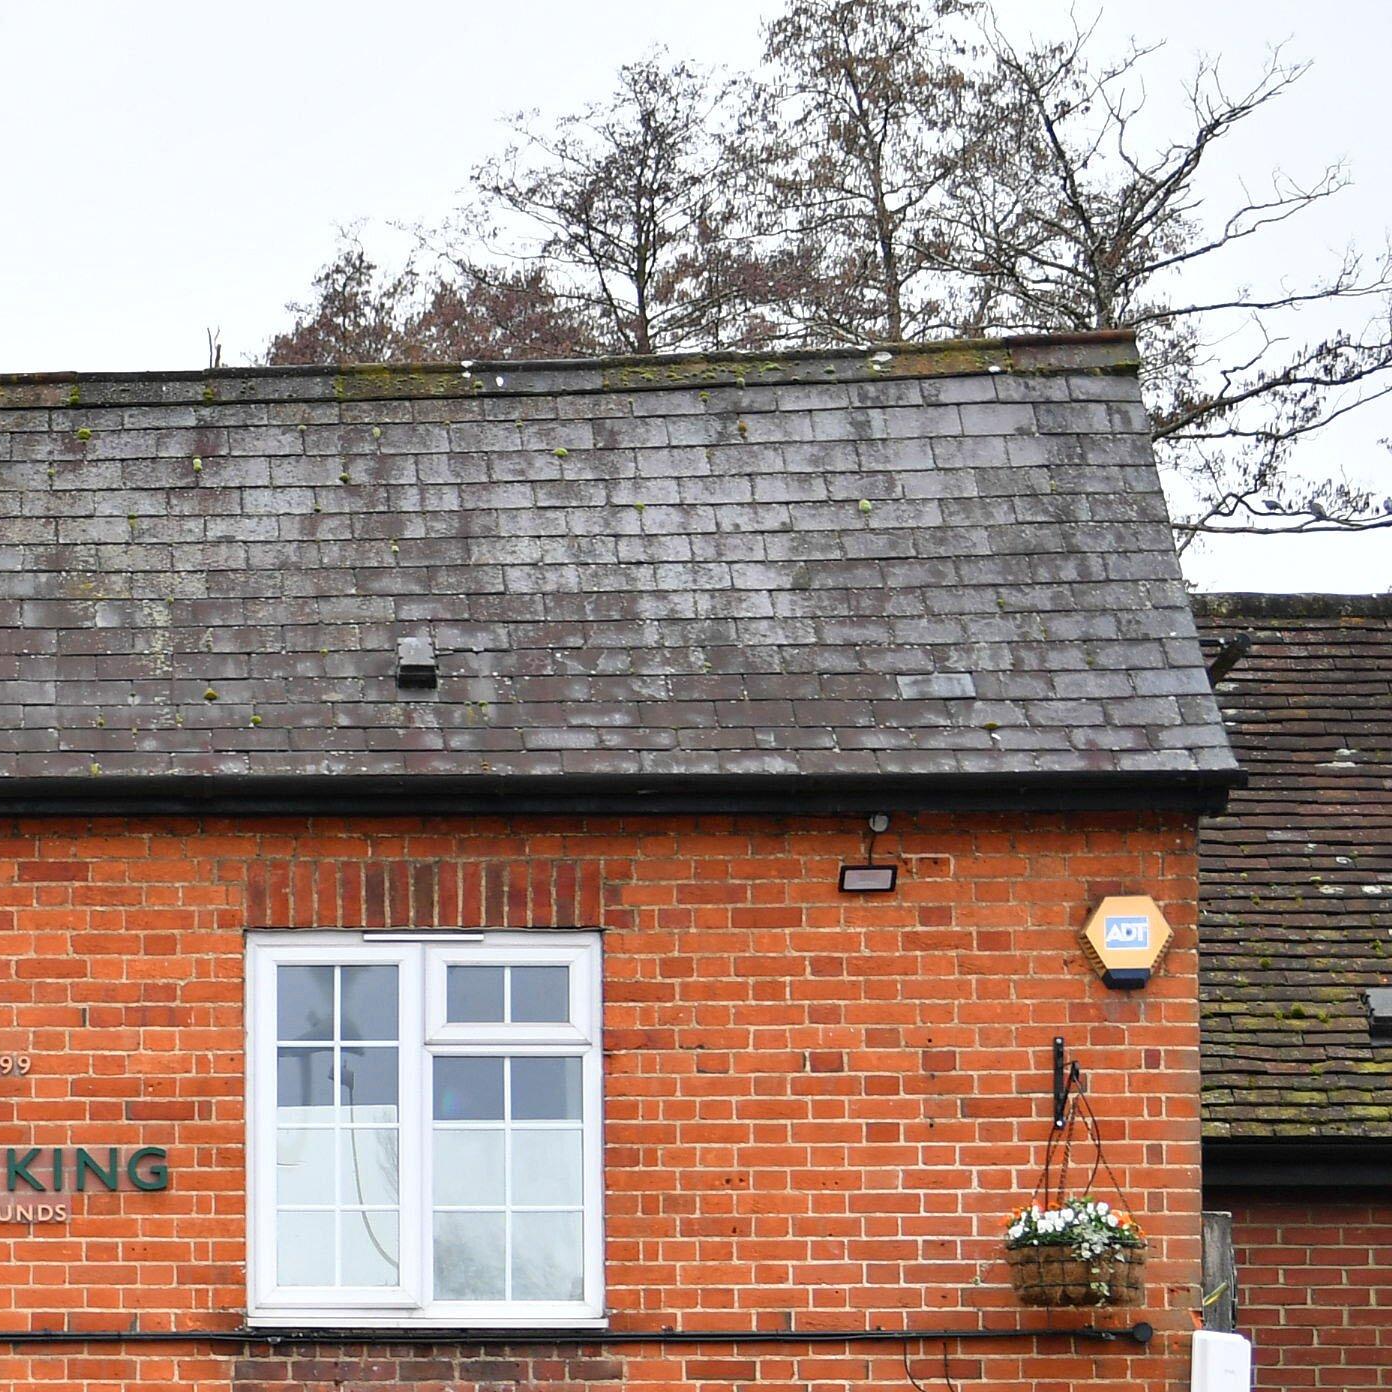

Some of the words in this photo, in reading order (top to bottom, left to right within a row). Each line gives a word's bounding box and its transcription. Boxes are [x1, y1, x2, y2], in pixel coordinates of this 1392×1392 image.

[1106, 923, 1148, 942] ADT
[0, 1055, 32, 1075] 99
[6, 1146, 170, 1193] KING
